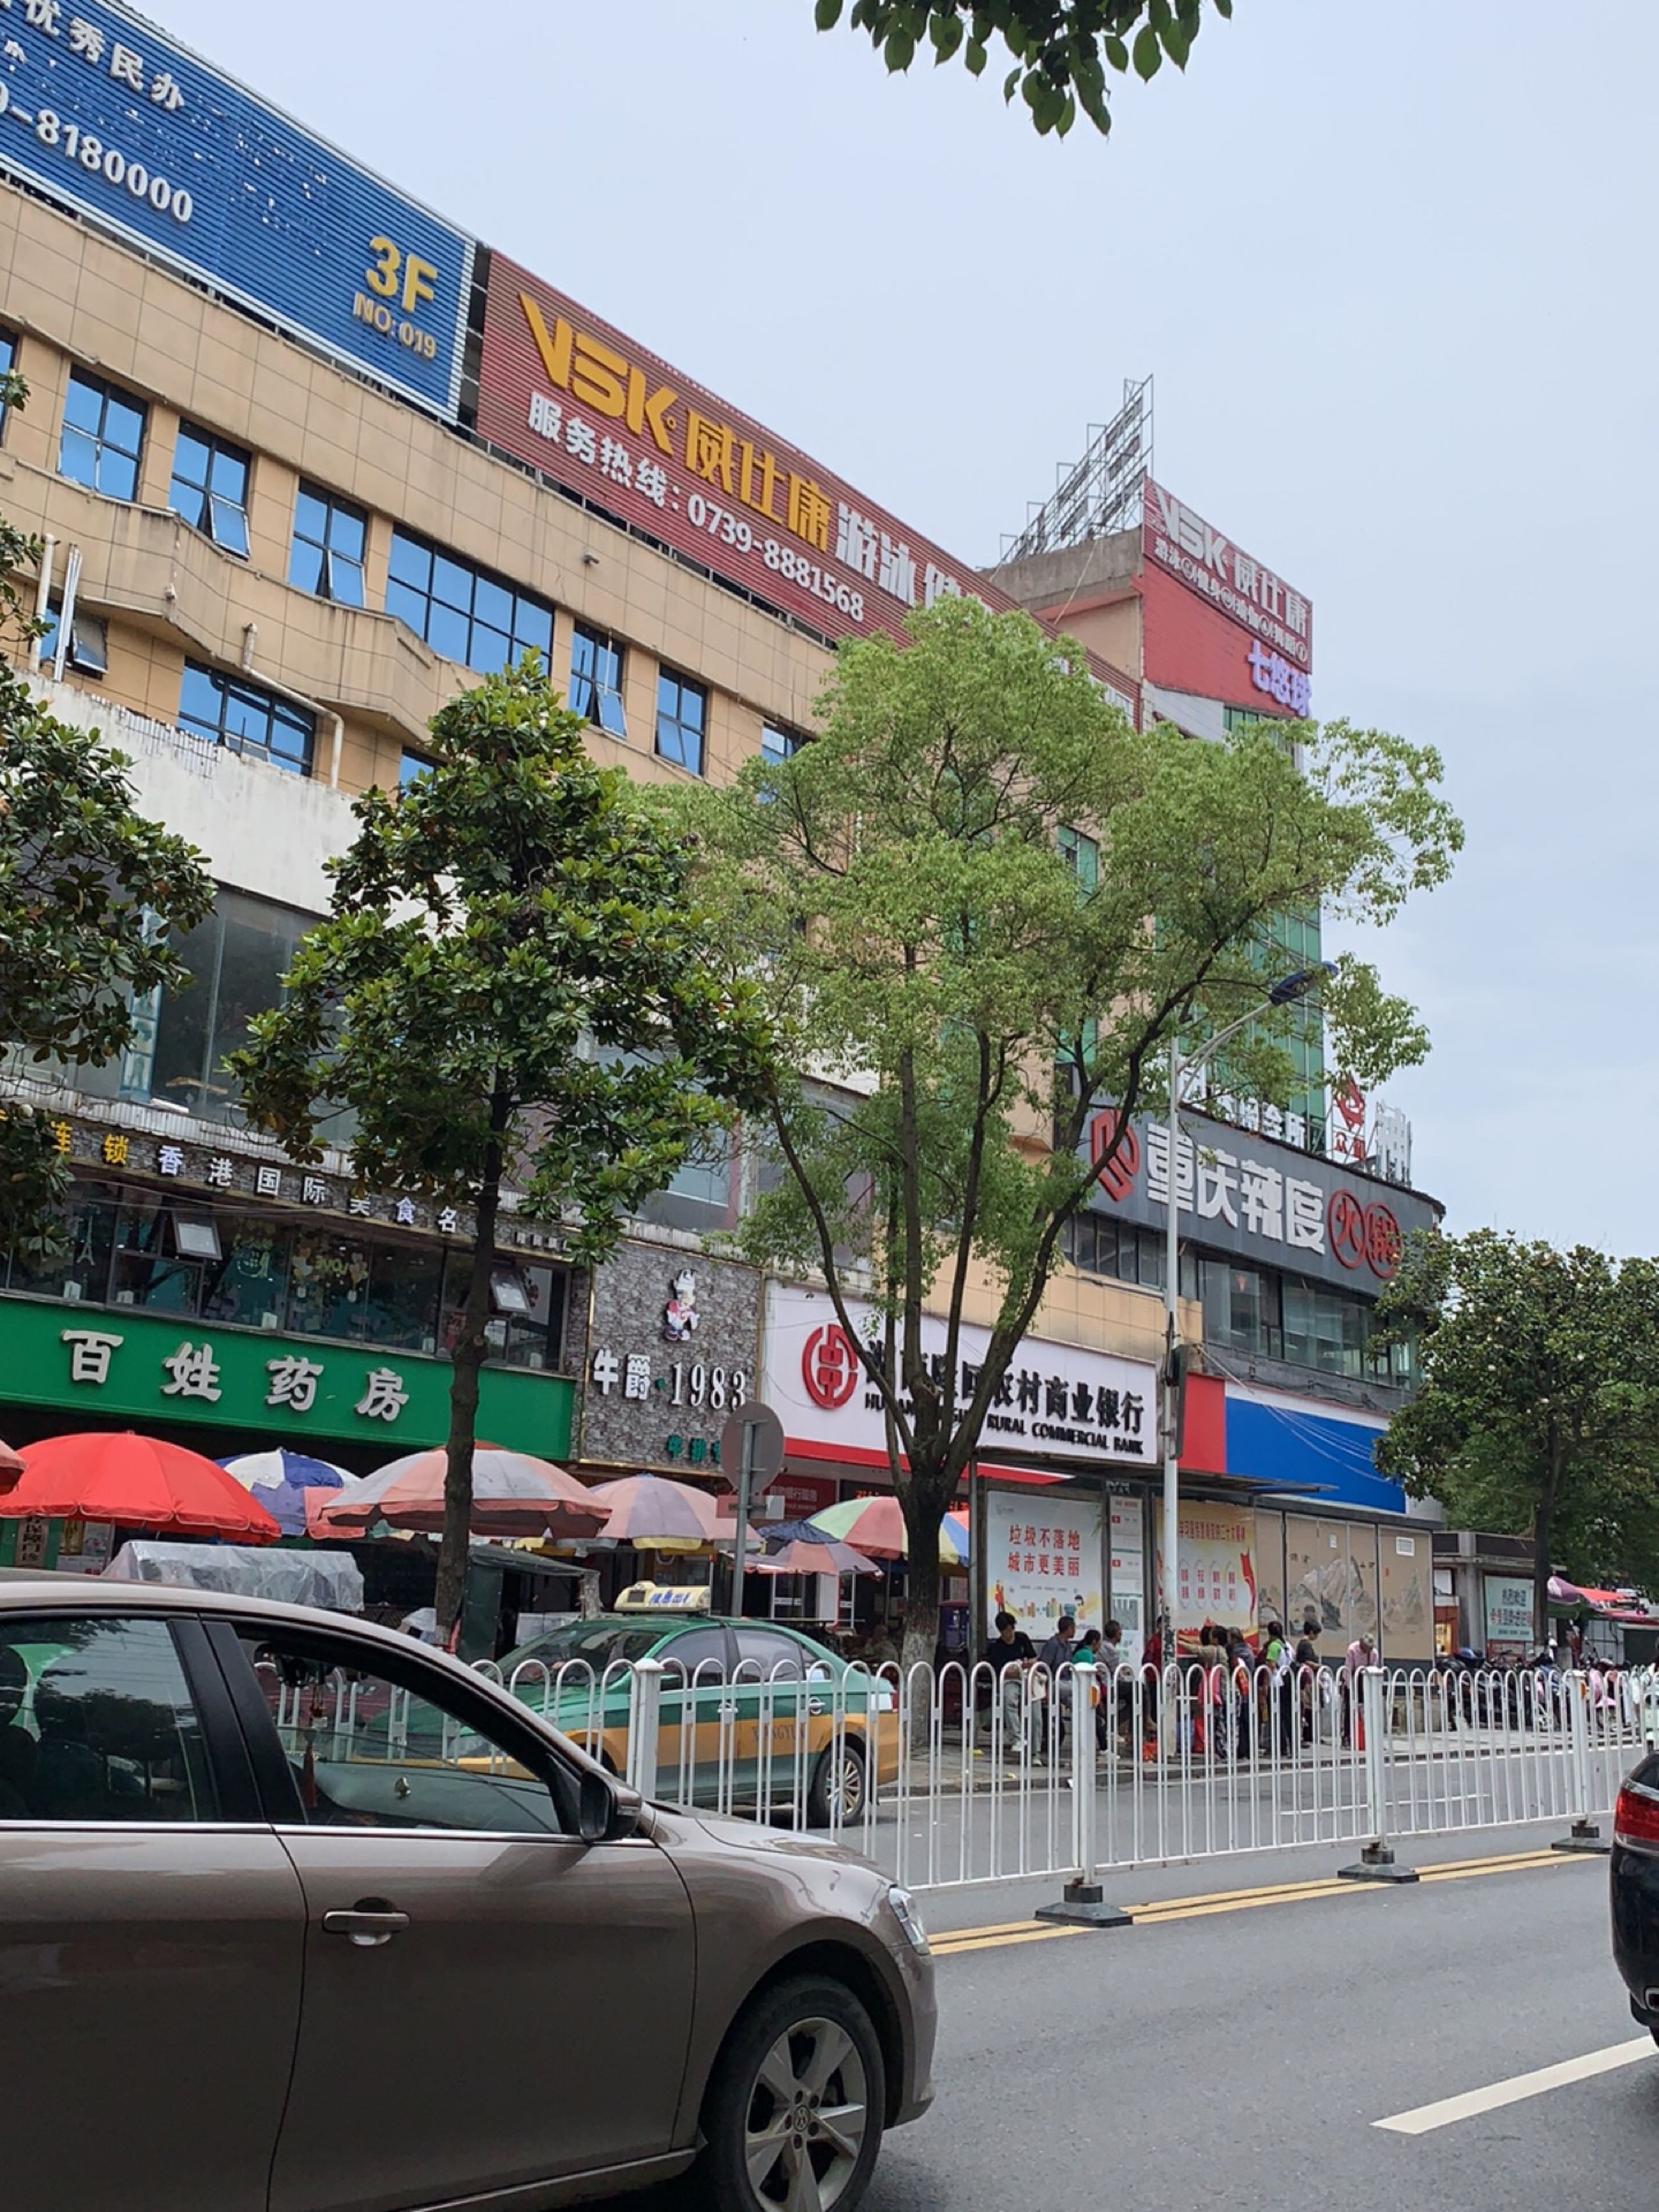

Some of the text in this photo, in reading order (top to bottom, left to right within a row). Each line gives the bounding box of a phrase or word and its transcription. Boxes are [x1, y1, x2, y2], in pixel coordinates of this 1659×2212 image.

[0, 0, 185, 110] 优秀民办
[365, 236, 438, 313] 3F
[353, 291, 437, 359] NO:019
[519, 293, 678, 455] VSK
[685, 408, 832, 553] 威仕康
[1154, 485, 1228, 579] VSK
[61, 1329, 410, 1422] 百姓药房
[986, 1413, 1027, 1436] RURAL
[1031, 1422, 1110, 1450] COMMERCIAL
[1113, 1436, 1144, 1455] BANK
[1007, 1551, 1080, 1577] 城市更美丽
[1009, 1524, 1081, 1551] 垃圾不落地
